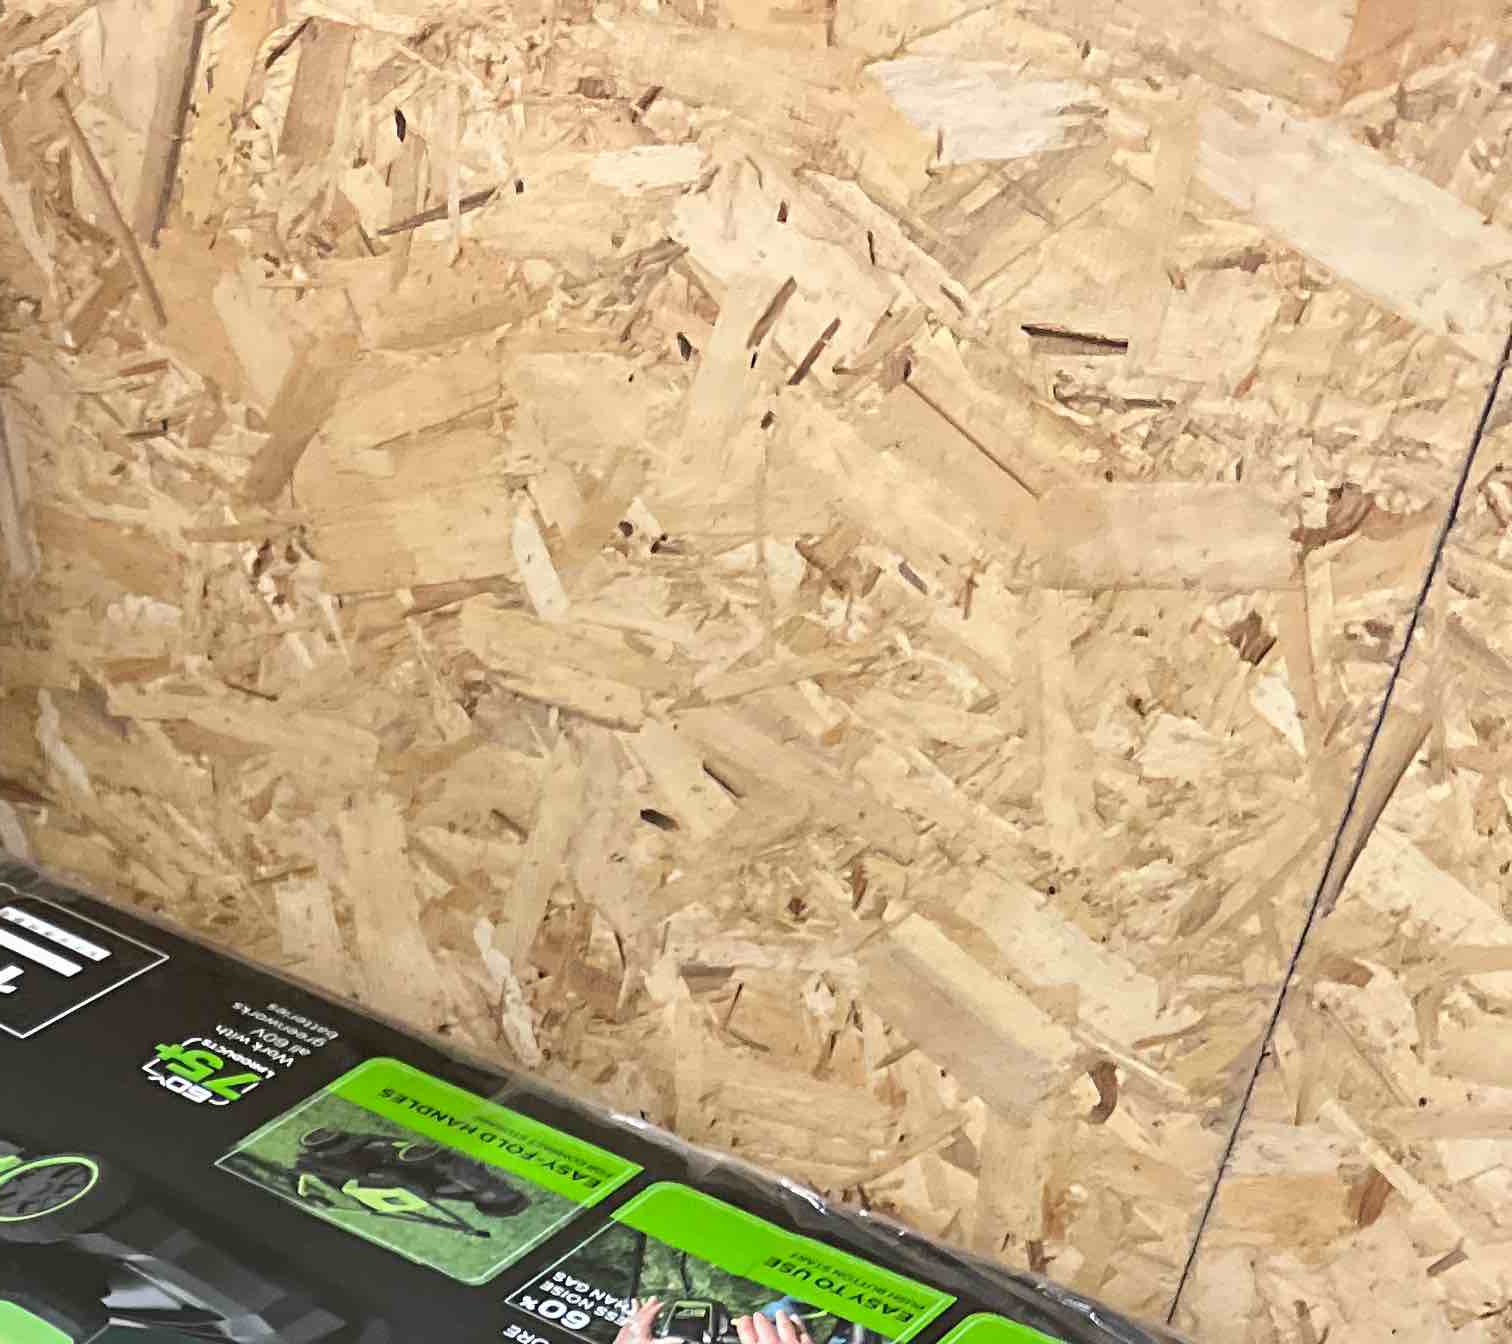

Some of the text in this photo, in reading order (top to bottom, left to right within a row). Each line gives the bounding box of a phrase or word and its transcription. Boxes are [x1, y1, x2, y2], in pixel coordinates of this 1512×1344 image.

[227, 1000, 329, 1047] greenworks
[248, 1027, 290, 1046] 60V
[262, 1002, 341, 1039] batteries
[197, 1038, 270, 1072] PRODUCTS
[211, 1023, 297, 1066] Work with
[157, 1042, 259, 1099] 75+
[377, 1087, 479, 1133] HANDLES
[475, 1131, 602, 1188] EASY-FOLD
[537, 1279, 595, 1309] NOISE
[549, 1270, 592, 1293] GAS
[765, 1256, 914, 1322] EASY TO USE
